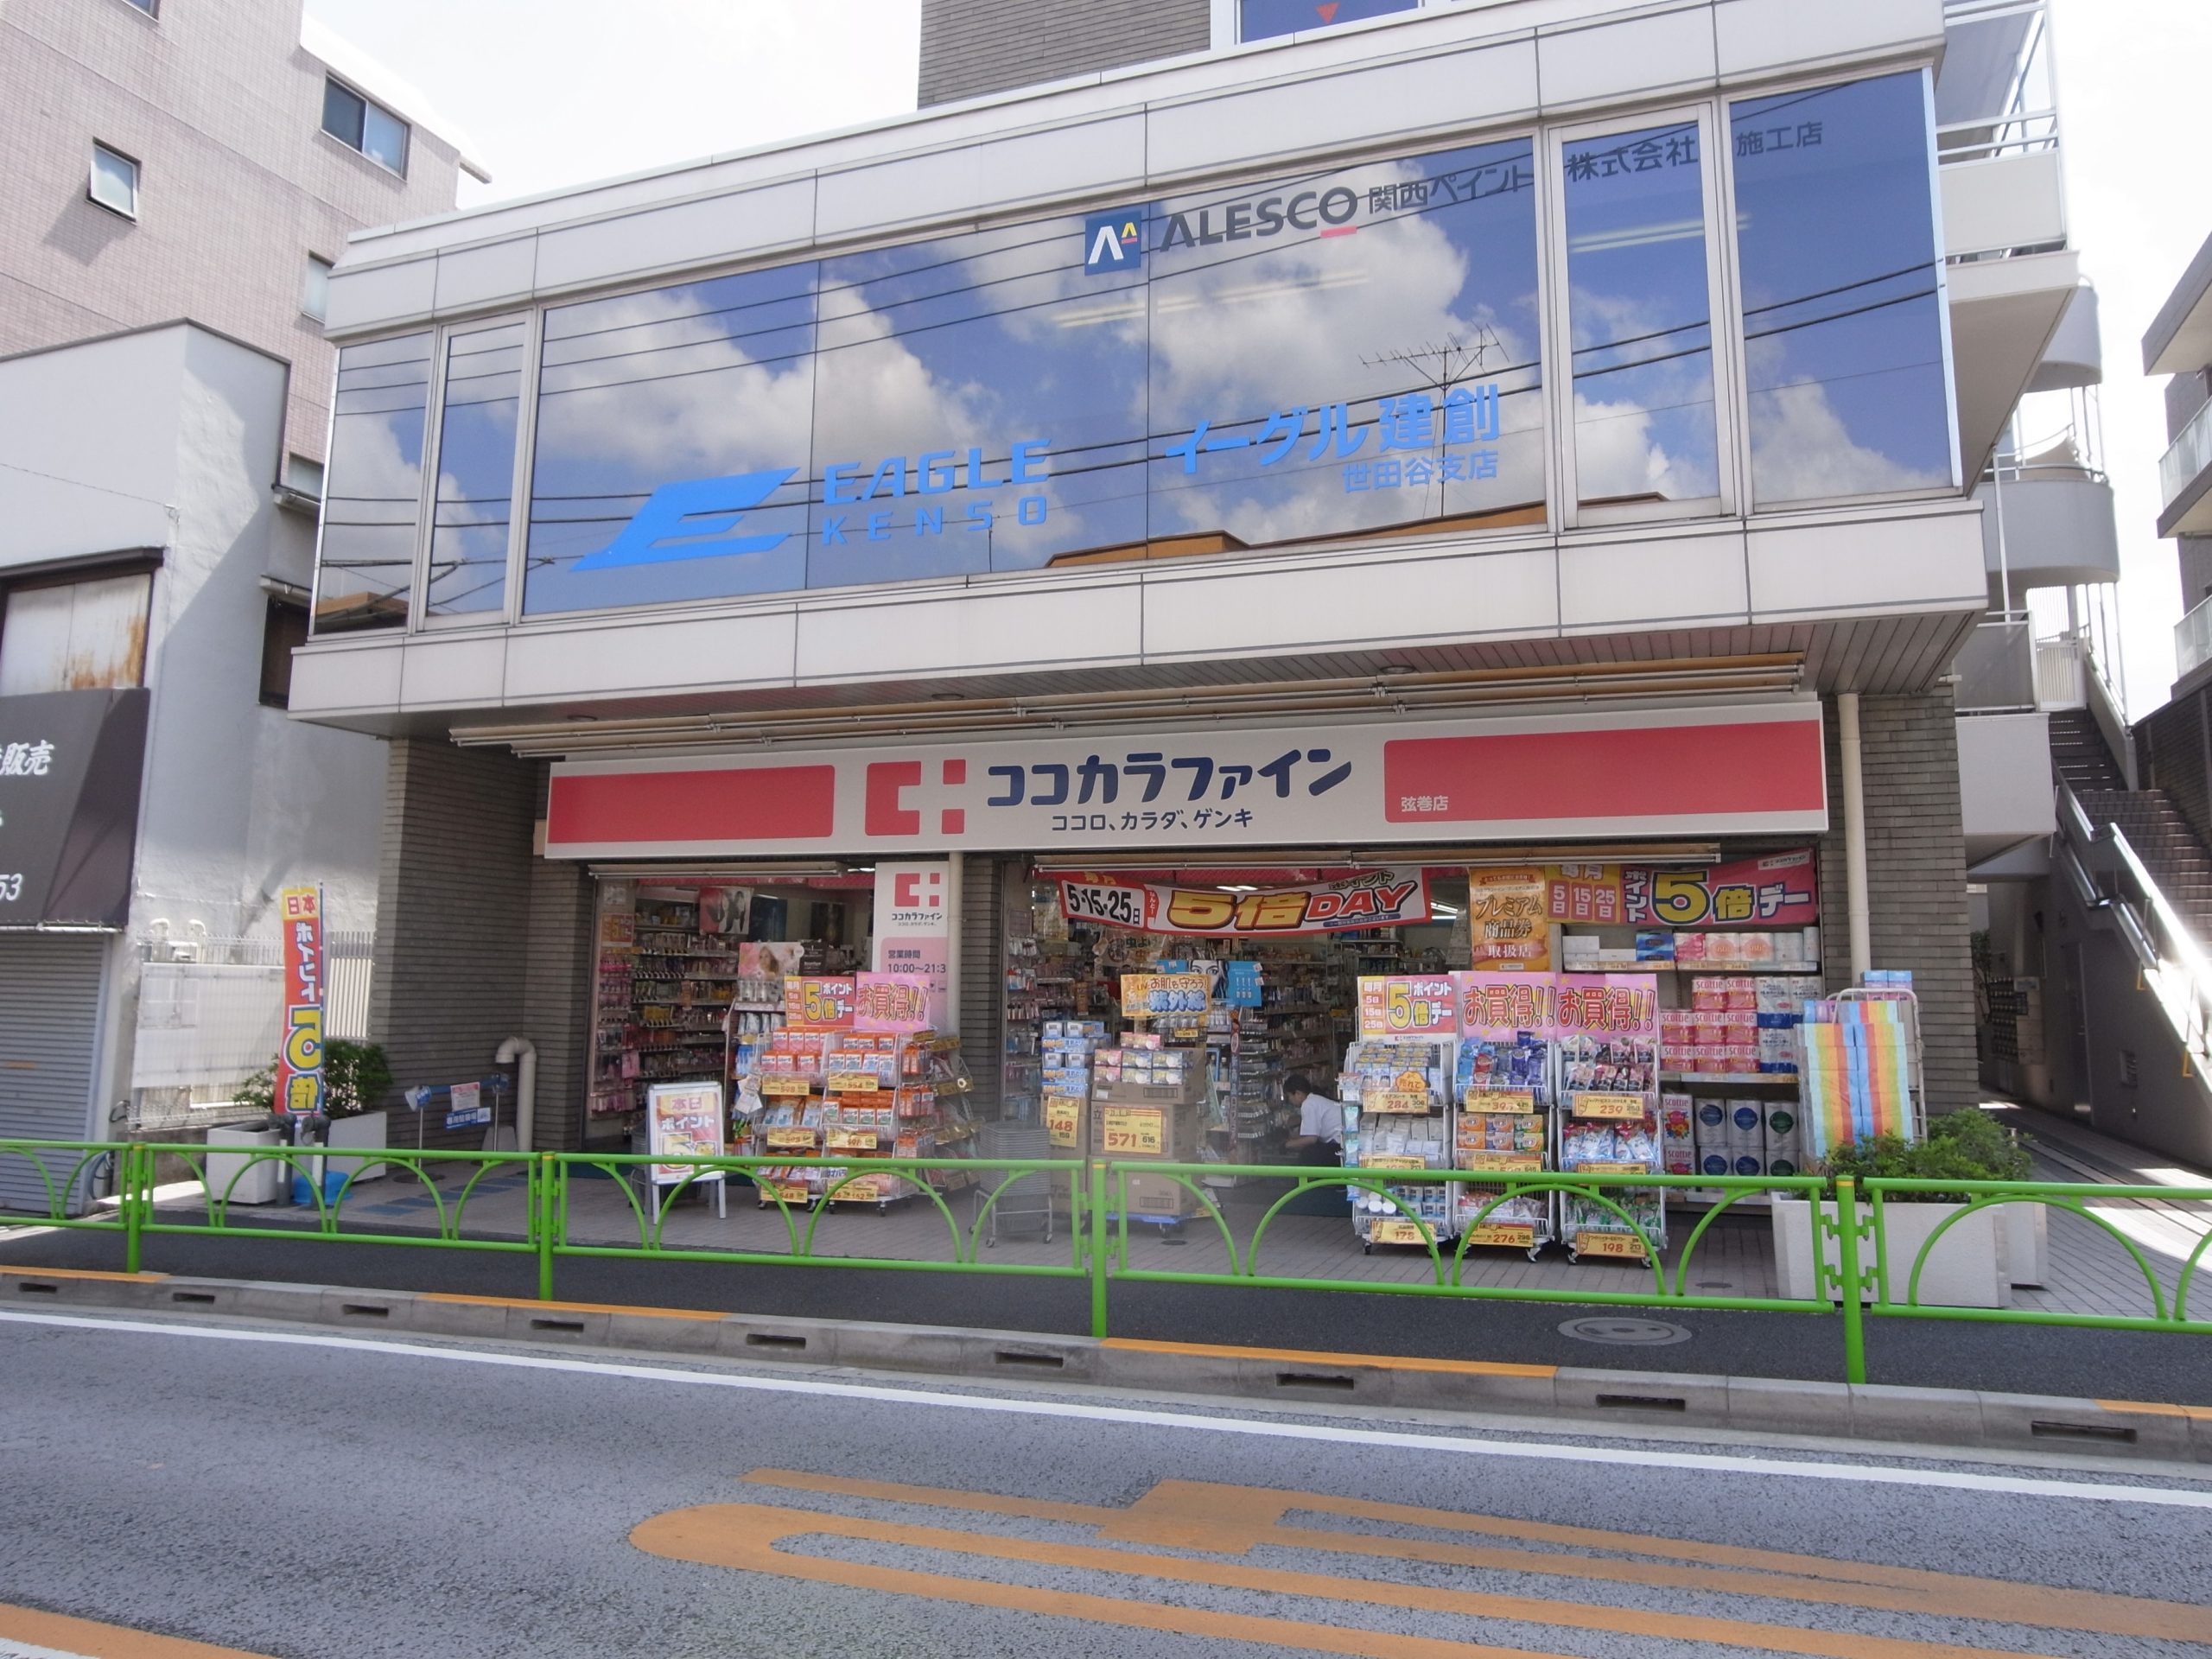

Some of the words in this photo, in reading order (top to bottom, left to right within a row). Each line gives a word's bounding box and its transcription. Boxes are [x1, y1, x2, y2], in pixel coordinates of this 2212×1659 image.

[1160, 187, 1357, 253] ALESCO
[1368, 164, 1535, 215] 関西ペイント
[1567, 136, 1699, 183] 株式会社
[1736, 122, 1823, 158] 施工店
[823, 438, 1052, 505] EAGLE
[1342, 449, 1499, 494] 世田谷支店
[823, 496, 1047, 546] KENSO
[0, 740, 55, 776] 販売
[987, 748, 1352, 807] ココカラファイン
[1401, 794, 1449, 813] 弦巻店
[1052, 808, 1254, 832] ココロ、カラダ、ゲンキ
[892, 912, 943, 921] ココカラファイン
[1476, 894, 1543, 919] プレミアム
[1484, 918, 1533, 939] 商品券
[888, 950, 921, 959] 営業時間
[1488, 944, 1532, 958] 取扱店
[1049, 1119, 1073, 1132] 148
[1108, 1133, 1137, 1147] 571
[1492, 1234, 1515, 1243] 276
[1603, 1243, 1624, 1252] 198
